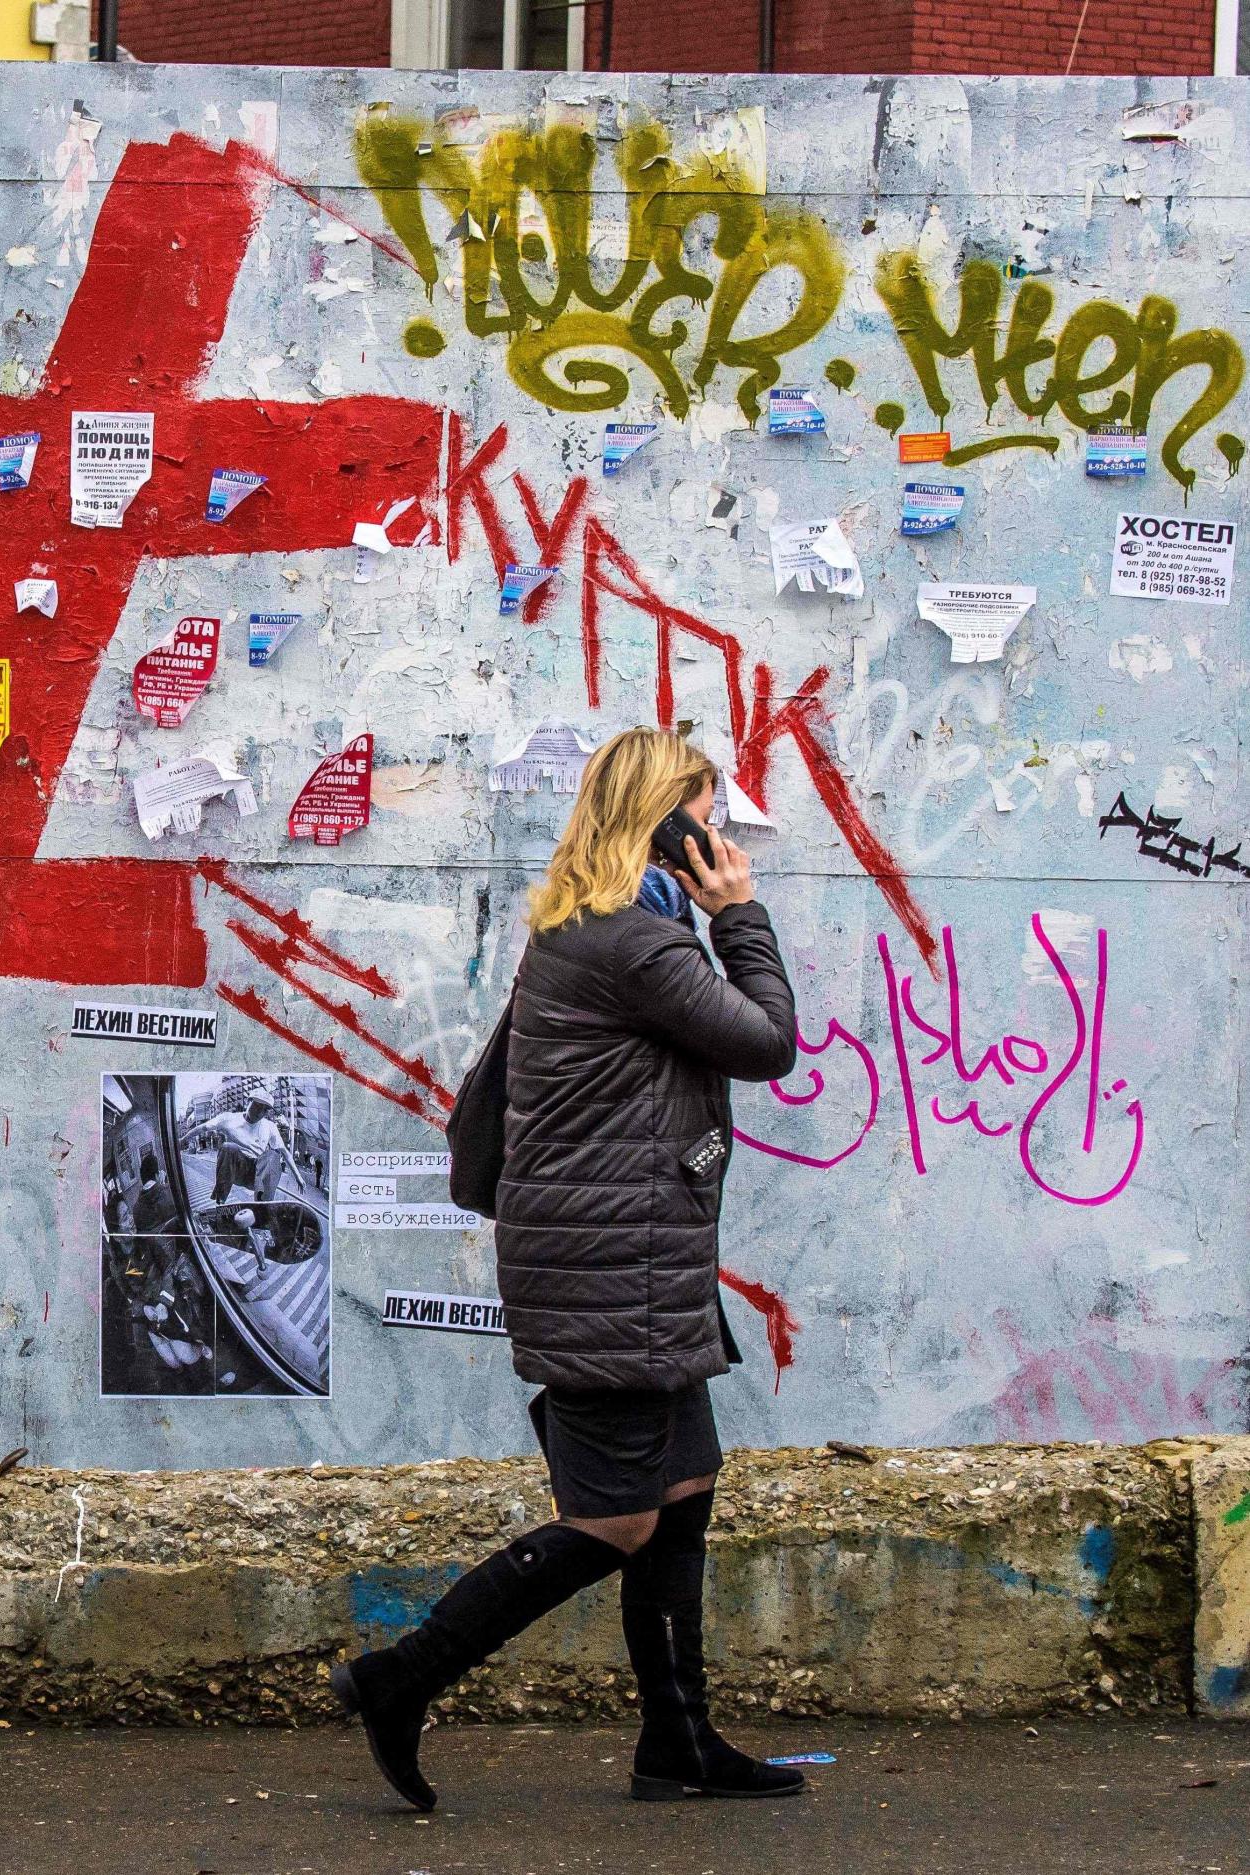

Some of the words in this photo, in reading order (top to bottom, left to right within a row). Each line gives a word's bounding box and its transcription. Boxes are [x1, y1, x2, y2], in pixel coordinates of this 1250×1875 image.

[77, 432, 150, 446] ПОМОЩЬ
[77, 447, 150, 461] ЛЮДЯМ
[914, 485, 957, 496] ПОМОЩЬ
[1120, 516, 1234, 545] ХОСТЕЛ
[1157, 541, 1228, 554] Красносельская
[1185, 554, 1213, 563] Ашана
[1169, 563, 1183, 571] 400
[1184, 565, 1220, 575] р./сутки
[1118, 570, 1138, 579] тел.
[1142, 571, 1147, 579] 8
[1150, 571, 1175, 583] (925)
[1178, 574, 1226, 587] 187-98-52
[949, 591, 1012, 600] ТРЕБУЮТСЯ
[1140, 582, 1146, 591] 8
[1149, 583, 1174, 595] (985)
[1177, 586, 1226, 598] 069-32-11
[178, 620, 215, 637] ОТА
[146, 656, 205, 670] ПИТАНИЕ
[138, 673, 174, 683] Мужчины,
[330, 801, 360, 809] Украины
[293, 814, 299, 823] 8
[324, 815, 365, 826] 660-11-72
[72, 1008, 133, 1034] ЛЕХИН
[137, 1013, 216, 1040] ВЕСТНИК
[349, 1183, 395, 1196] есть
[347, 1211, 477, 1227] возбуждение
[383, 1296, 445, 1324] ЛЕХИН
[448, 1303, 505, 1329] ВЕСТН
